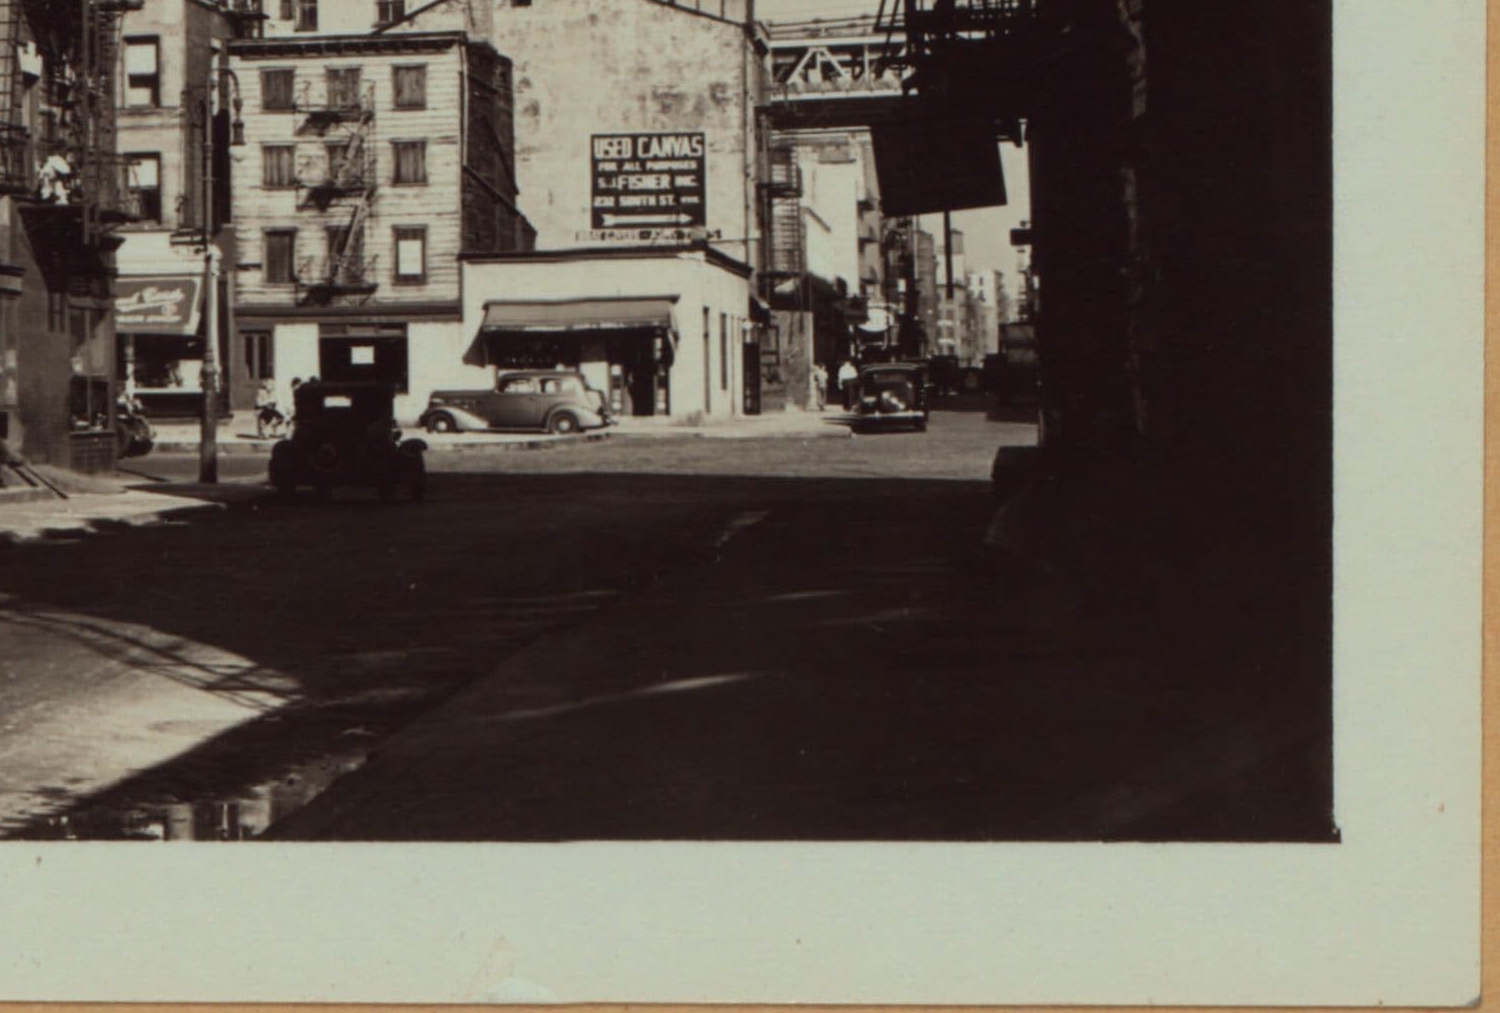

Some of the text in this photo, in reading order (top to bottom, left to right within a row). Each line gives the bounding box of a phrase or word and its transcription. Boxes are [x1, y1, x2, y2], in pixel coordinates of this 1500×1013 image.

[593, 135, 703, 159] USED CANVAS
[621, 160, 642, 171] ALL
[618, 173, 671, 190] FISHER
